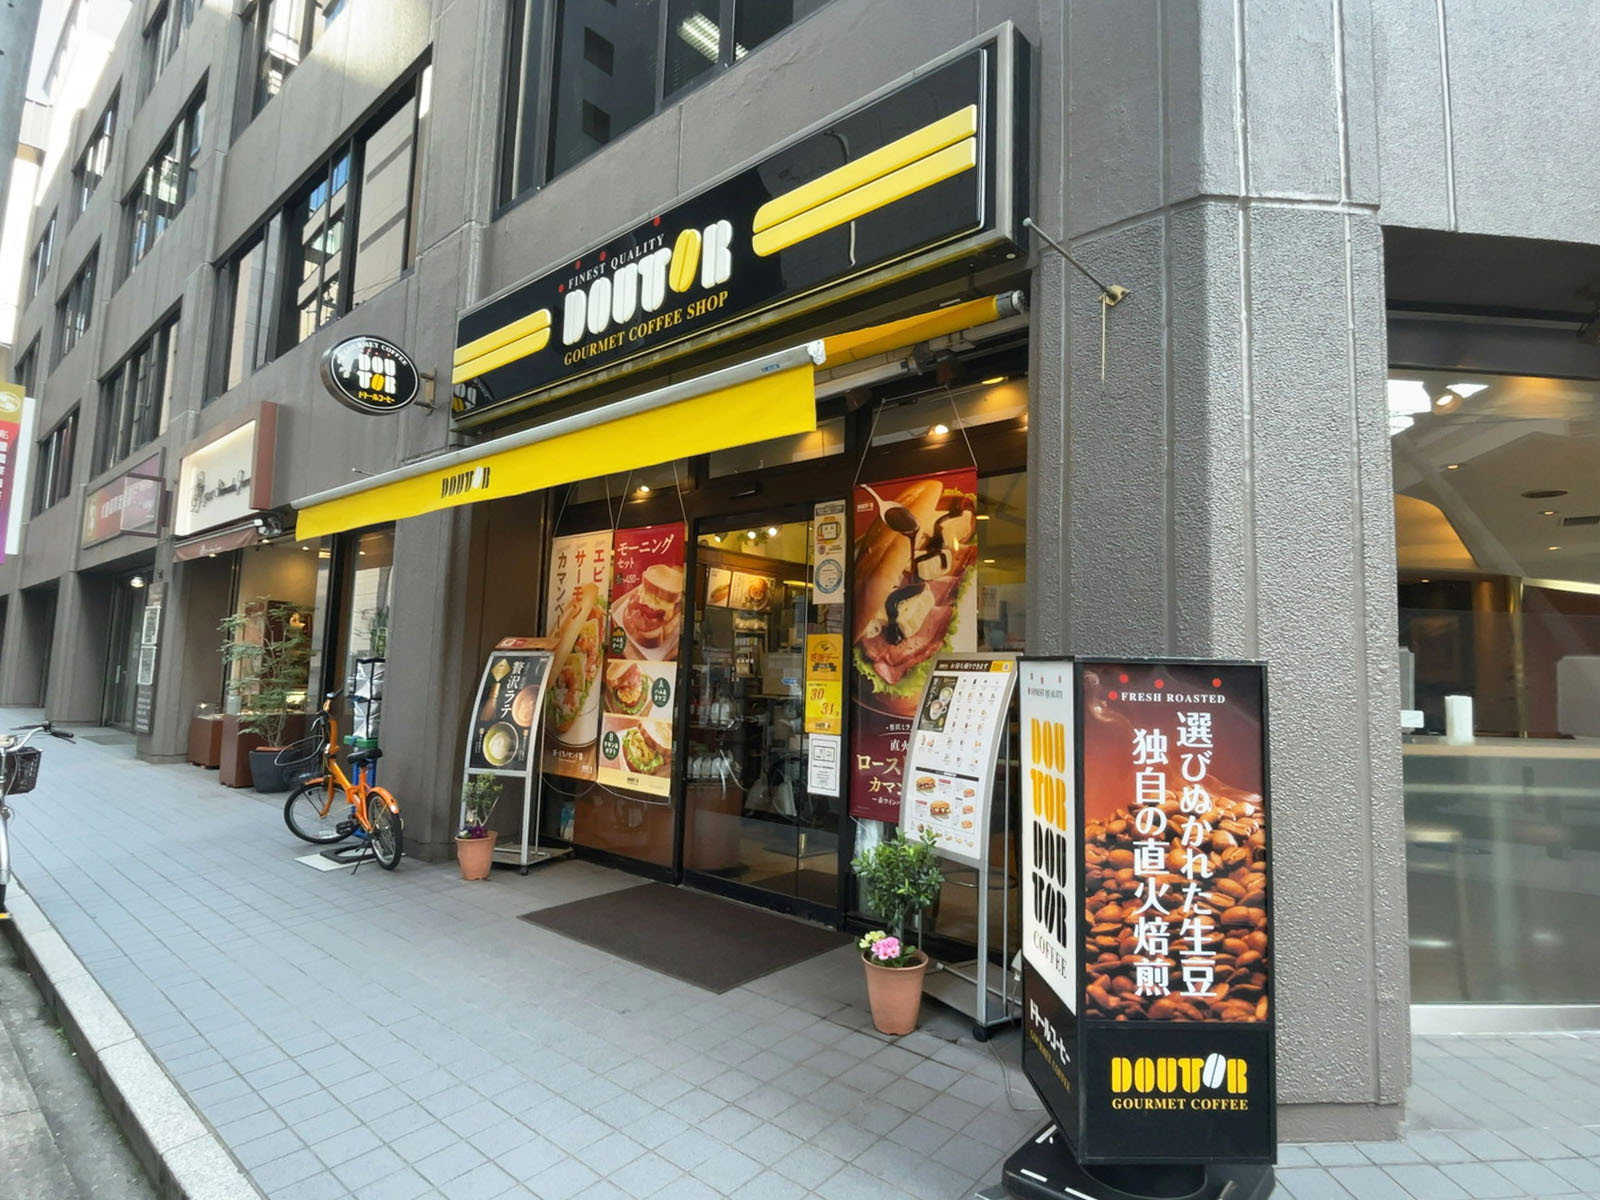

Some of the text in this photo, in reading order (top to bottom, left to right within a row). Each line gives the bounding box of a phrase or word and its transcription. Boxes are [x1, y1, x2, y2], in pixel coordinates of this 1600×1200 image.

[562, 219, 734, 346] DOUTOR
[568, 233, 665, 290] FINEST QUALITY
[563, 290, 729, 366] GOURMET COFFEE SHOP
[440, 466, 491, 499] DOUTOR
[593, 549, 605, 583] エビ
[616, 533, 675, 556] モーニング
[616, 557, 635, 569] セット
[572, 550, 587, 619] サーモン
[810, 688, 824, 701] 30
[821, 702, 834, 715] 31
[1120, 691, 1226, 705] FRESH ROASTED
[856, 754, 905, 776] ロース
[1031, 717, 1066, 774] DOU
[1030, 768, 1067, 832] TOR
[1033, 820, 1067, 889] DOU
[1131, 728, 1171, 997] 独自の直火焙煎
[1176, 711, 1217, 998] 選びぬかれた生豆
[1032, 871, 1067, 949] TOR
[1033, 930, 1067, 980] COFFEE
[1030, 998, 1071, 1066] ドトールコーヒー
[1111, 1052, 1248, 1094] DOUTOR
[1111, 1098, 1248, 1111] GOURMET COFFEE
